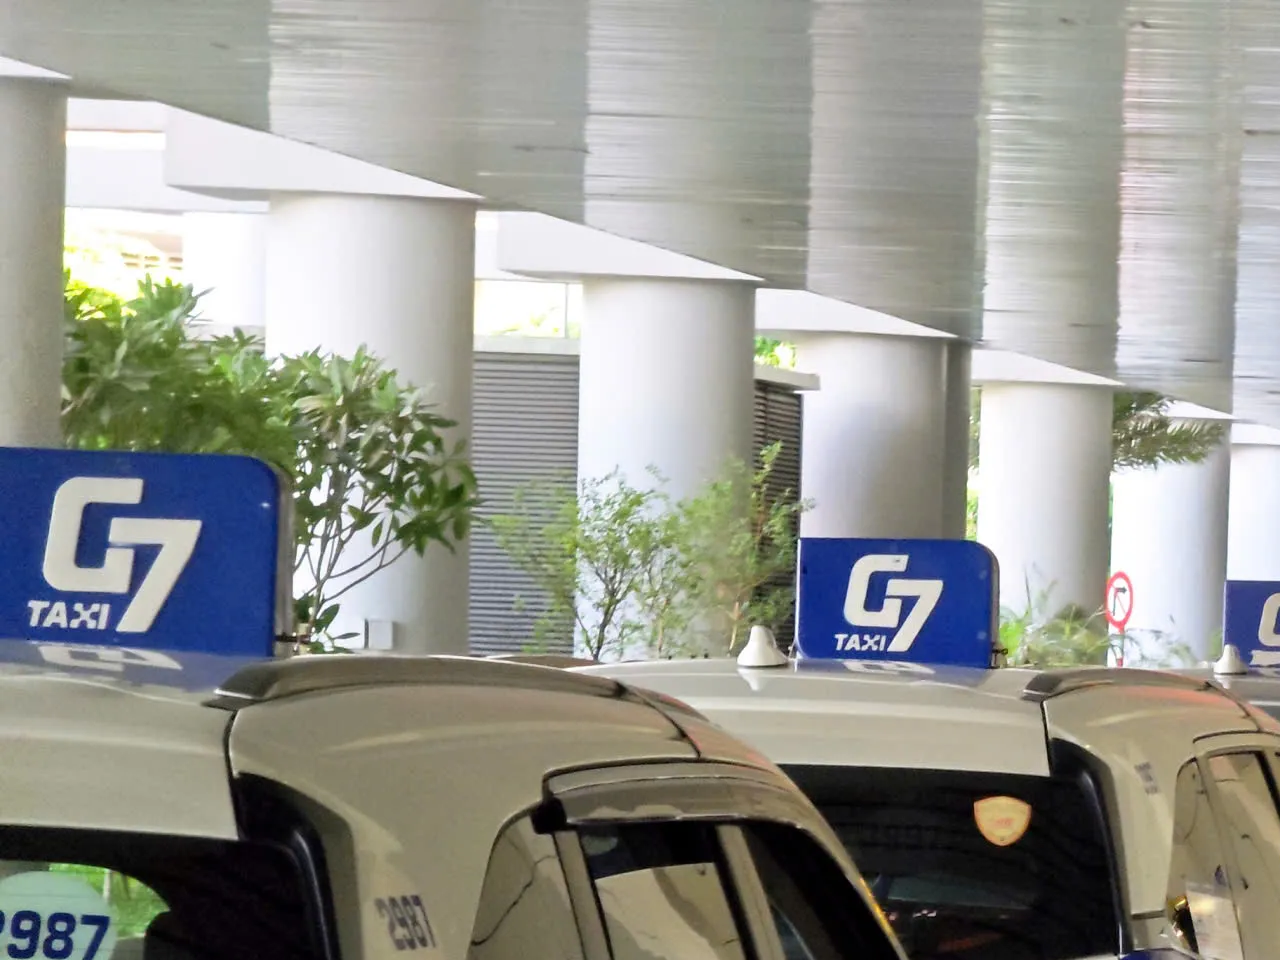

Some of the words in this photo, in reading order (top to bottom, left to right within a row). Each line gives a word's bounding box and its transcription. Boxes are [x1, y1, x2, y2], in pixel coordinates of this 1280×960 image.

[42, 475, 203, 633] G7
[27, 599, 110, 630] TAXI
[843, 554, 944, 653] G7
[834, 633, 887, 651] TAXI
[374, 895, 436, 951] 2987
